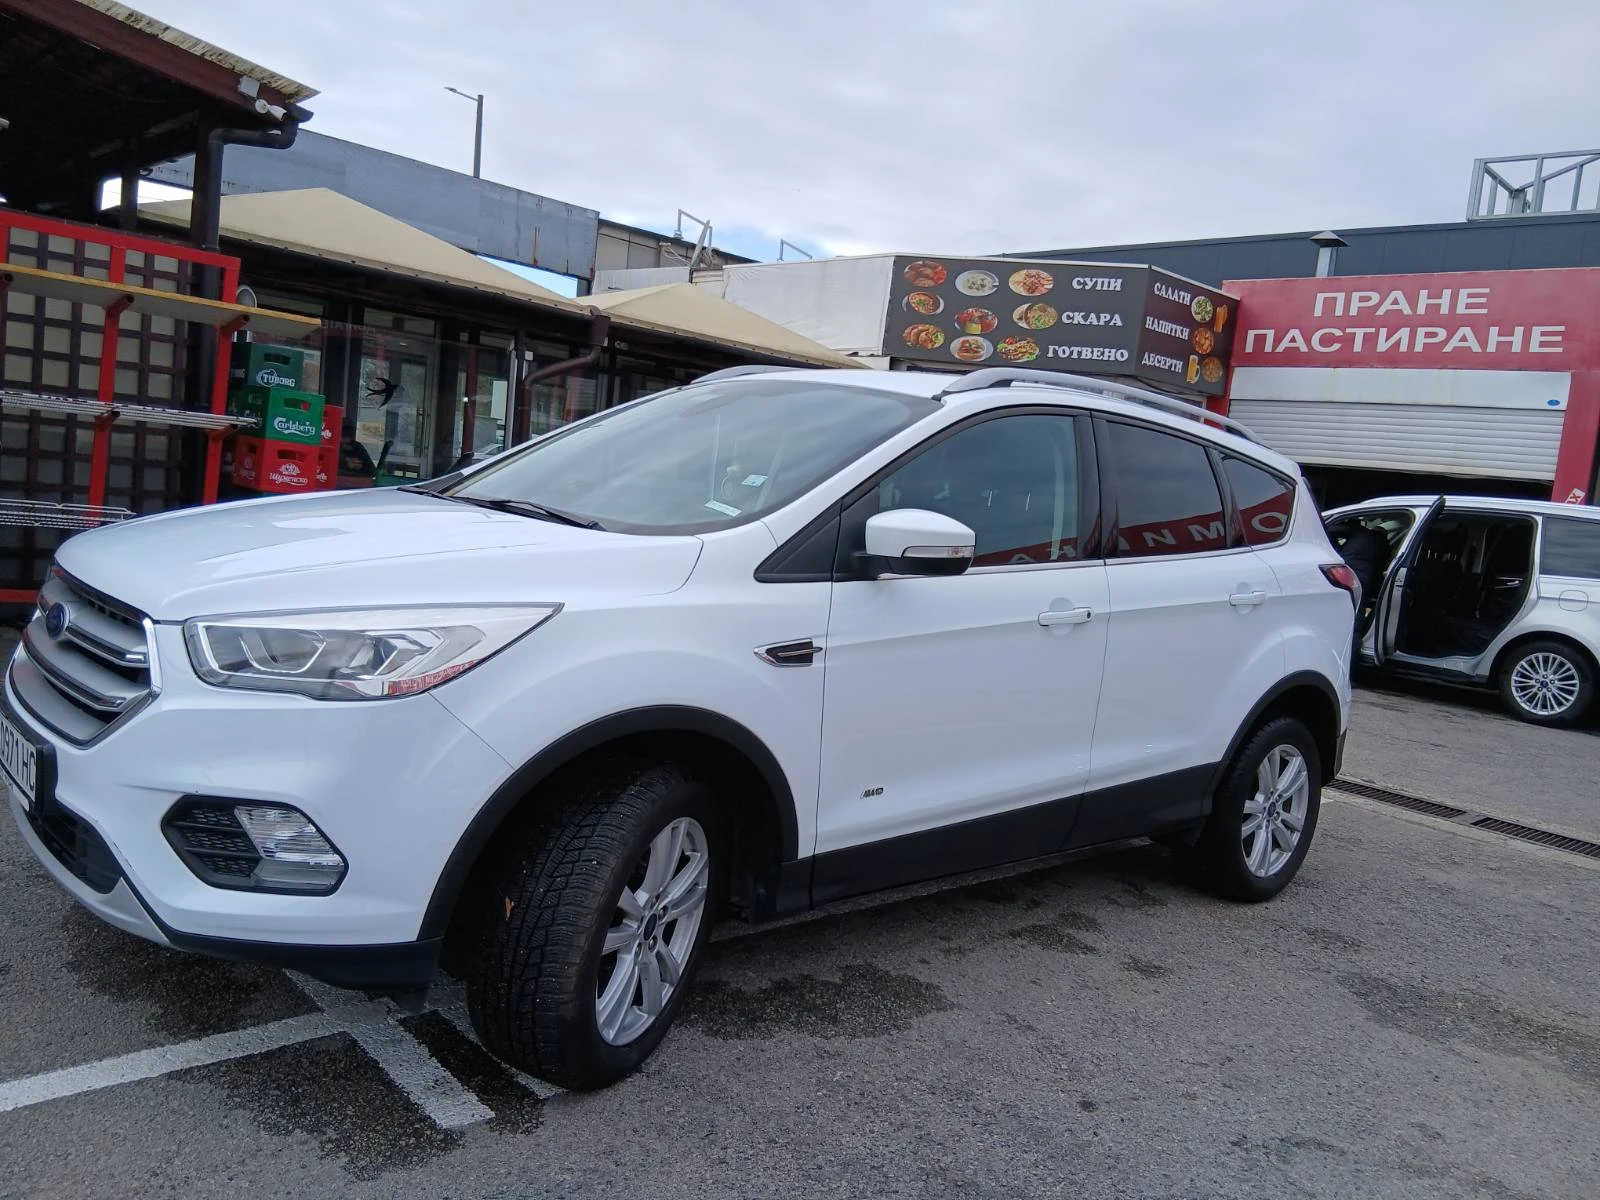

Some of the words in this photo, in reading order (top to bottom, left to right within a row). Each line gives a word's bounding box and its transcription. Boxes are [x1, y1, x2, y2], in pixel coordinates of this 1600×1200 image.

[1071, 276, 1123, 292] СУПИ
[1154, 281, 1191, 306] САЛАТИ
[1313, 286, 1491, 317] ПРАНЕ
[1061, 311, 1123, 327] СКАРА
[1145, 316, 1190, 341] НАПИТКИ
[1244, 325, 1567, 354] ПАСТИРАНЕ
[1047, 344, 1129, 362] ГОТВЕНО
[1142, 351, 1183, 373] ДЕСЕРТИ
[261, 372, 296, 387] TUBORG
[274, 417, 316, 437] Carlsberg
